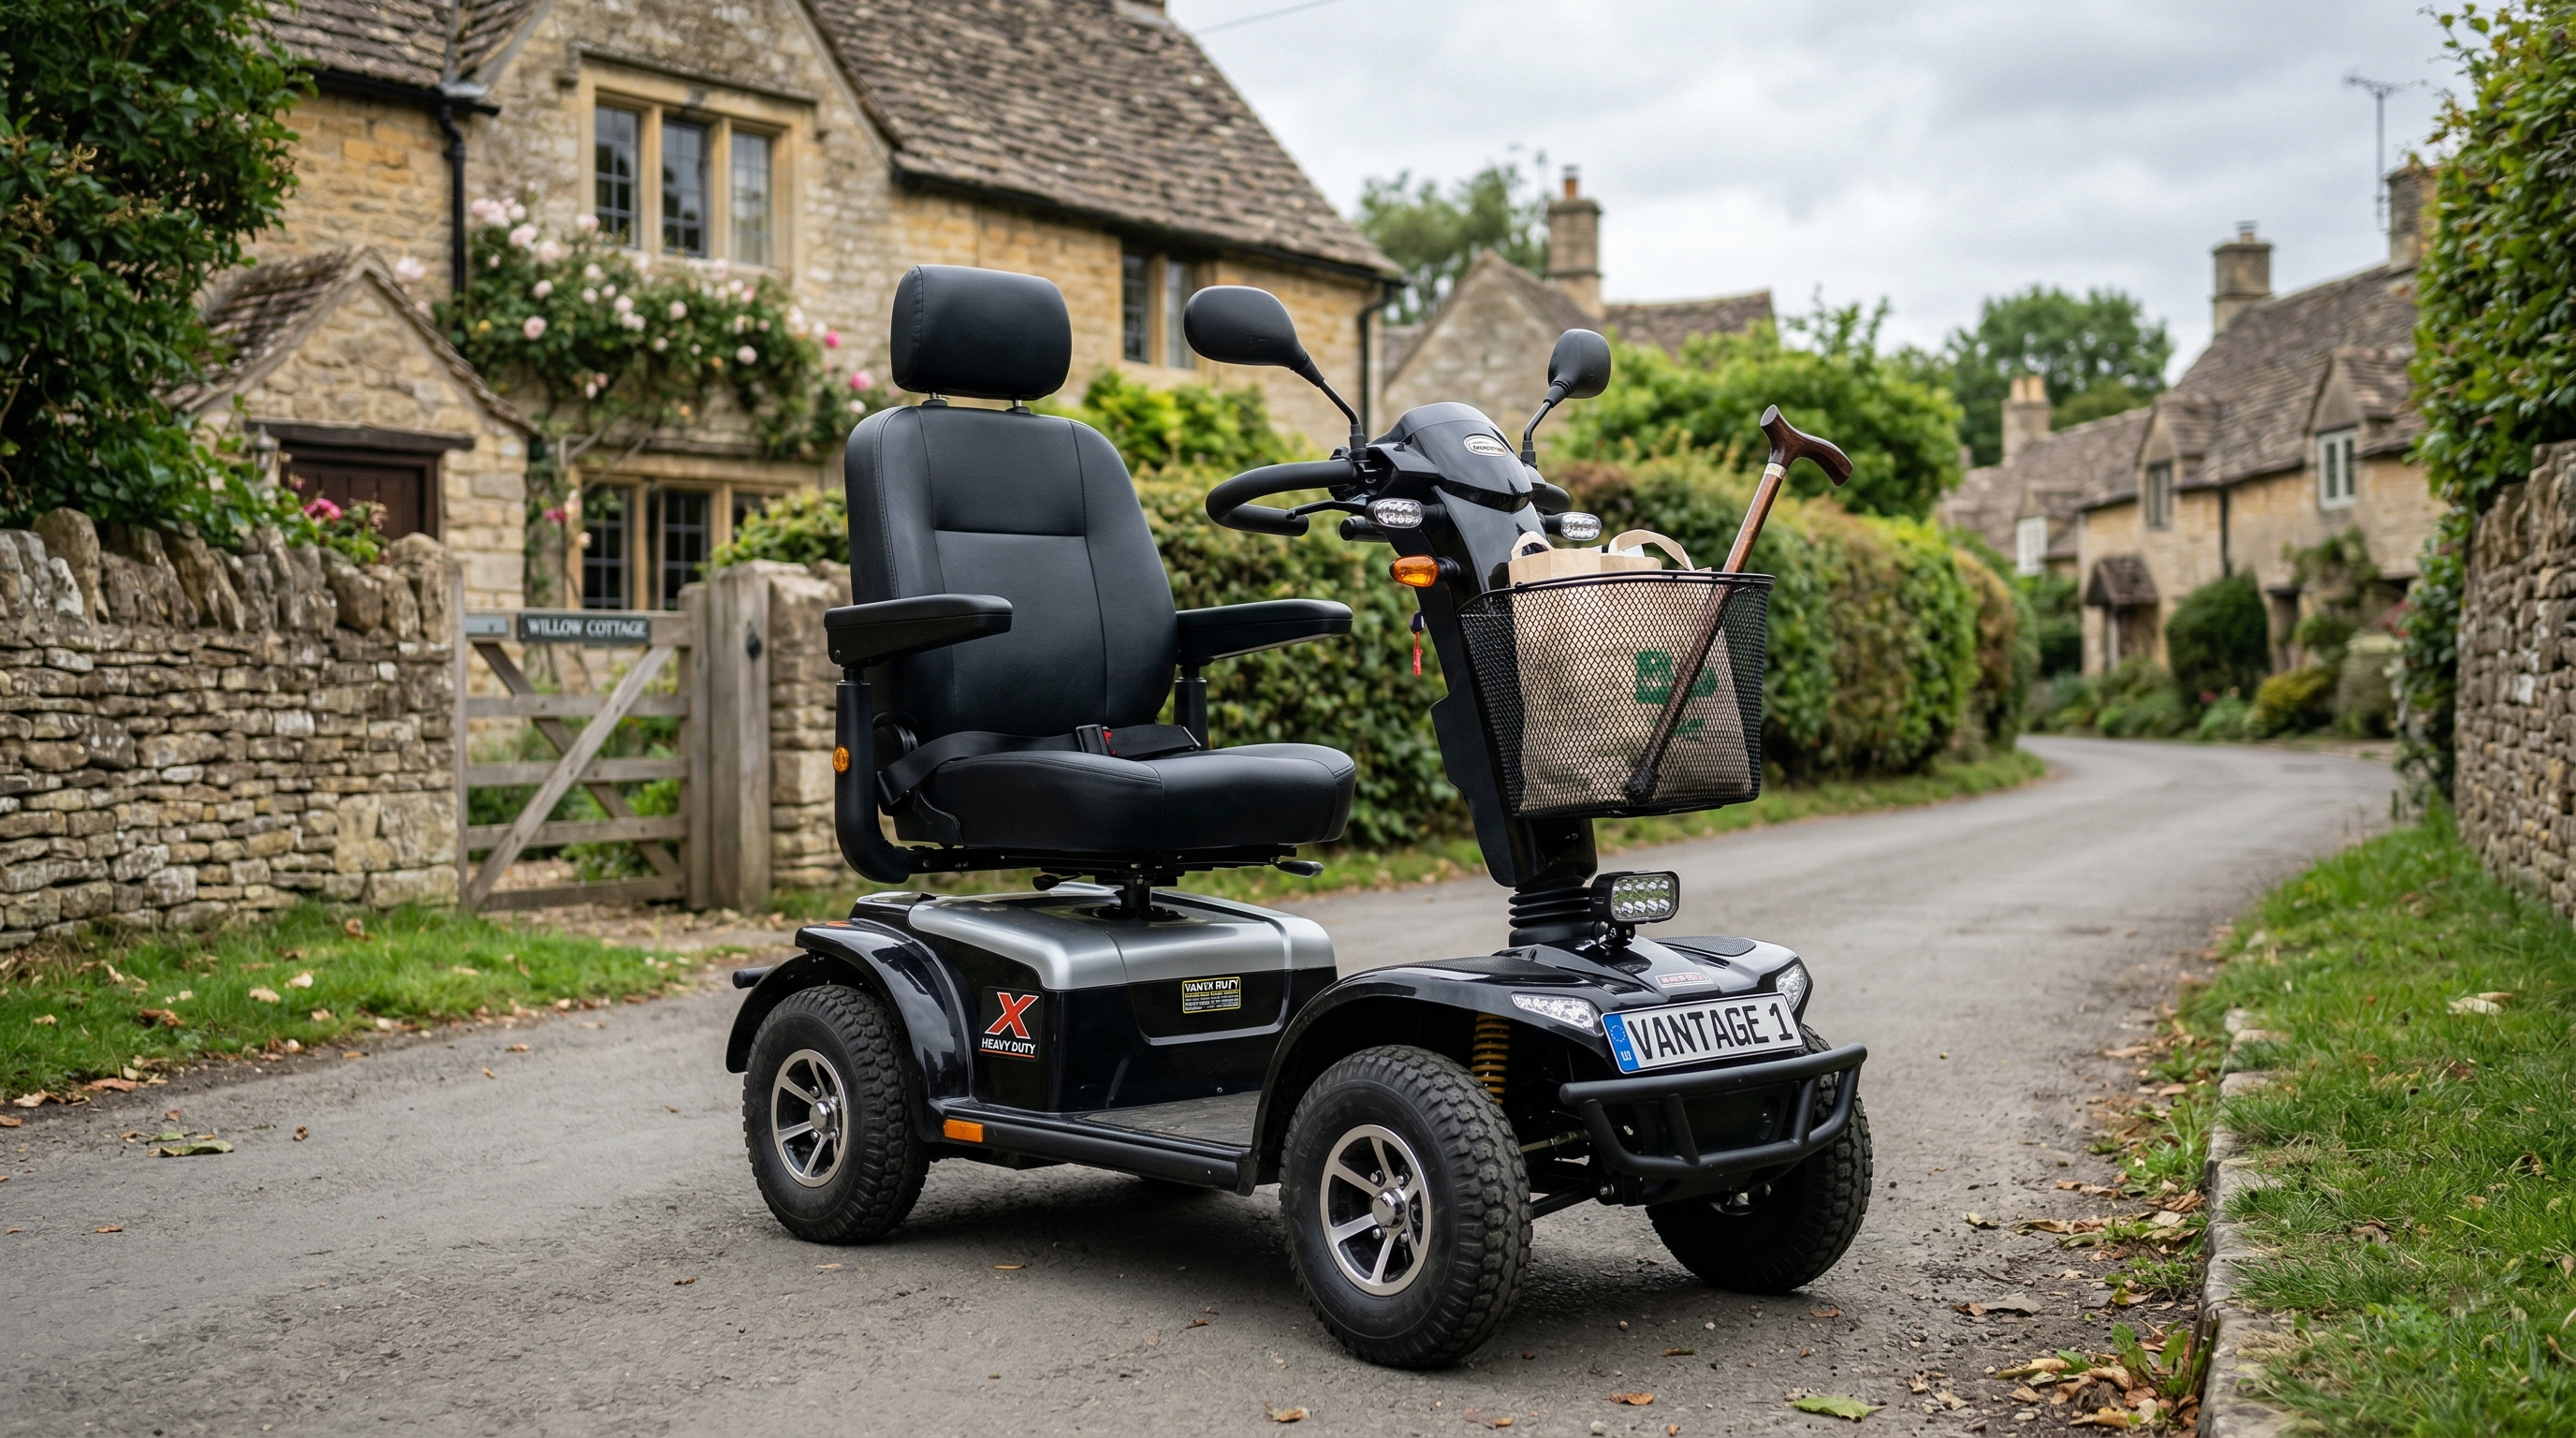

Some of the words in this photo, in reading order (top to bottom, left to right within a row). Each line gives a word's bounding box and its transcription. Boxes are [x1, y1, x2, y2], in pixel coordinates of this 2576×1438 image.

[527, 618, 584, 637] WILLOW
[586, 619, 648, 638] COTTAGE
[984, 991, 1039, 1040] X
[1627, 1005, 1770, 1061] VANTAGE
[1768, 1003, 1794, 1042] 1
[981, 1037, 1011, 1051] HEAVY
[1011, 1041, 1036, 1055] DUTY
